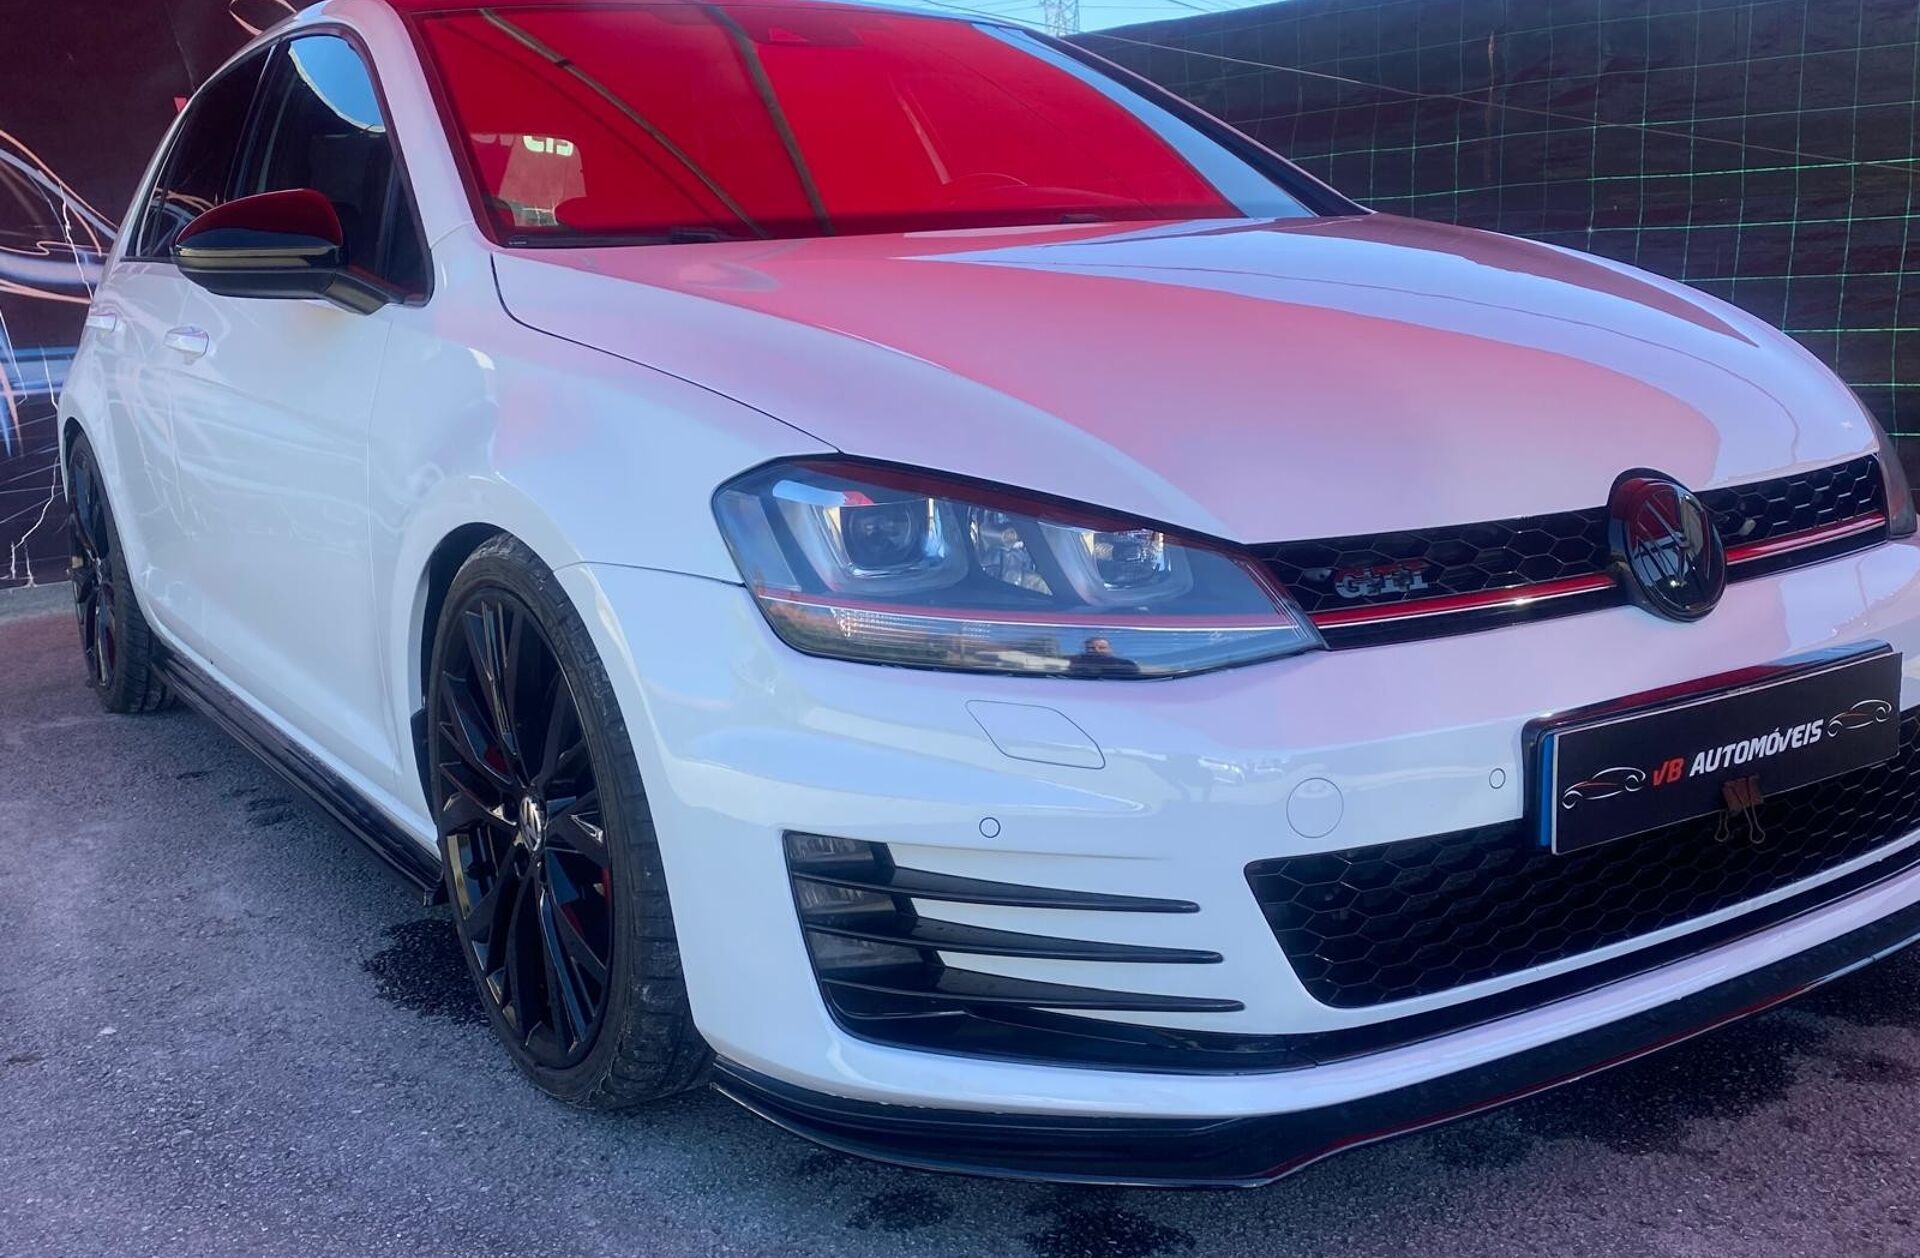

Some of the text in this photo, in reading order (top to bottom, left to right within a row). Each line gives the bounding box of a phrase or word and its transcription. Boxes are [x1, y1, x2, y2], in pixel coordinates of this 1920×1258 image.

[1335, 564, 1429, 599] GTI
[1652, 718, 1824, 787] VB AUTOMÓVEIS
